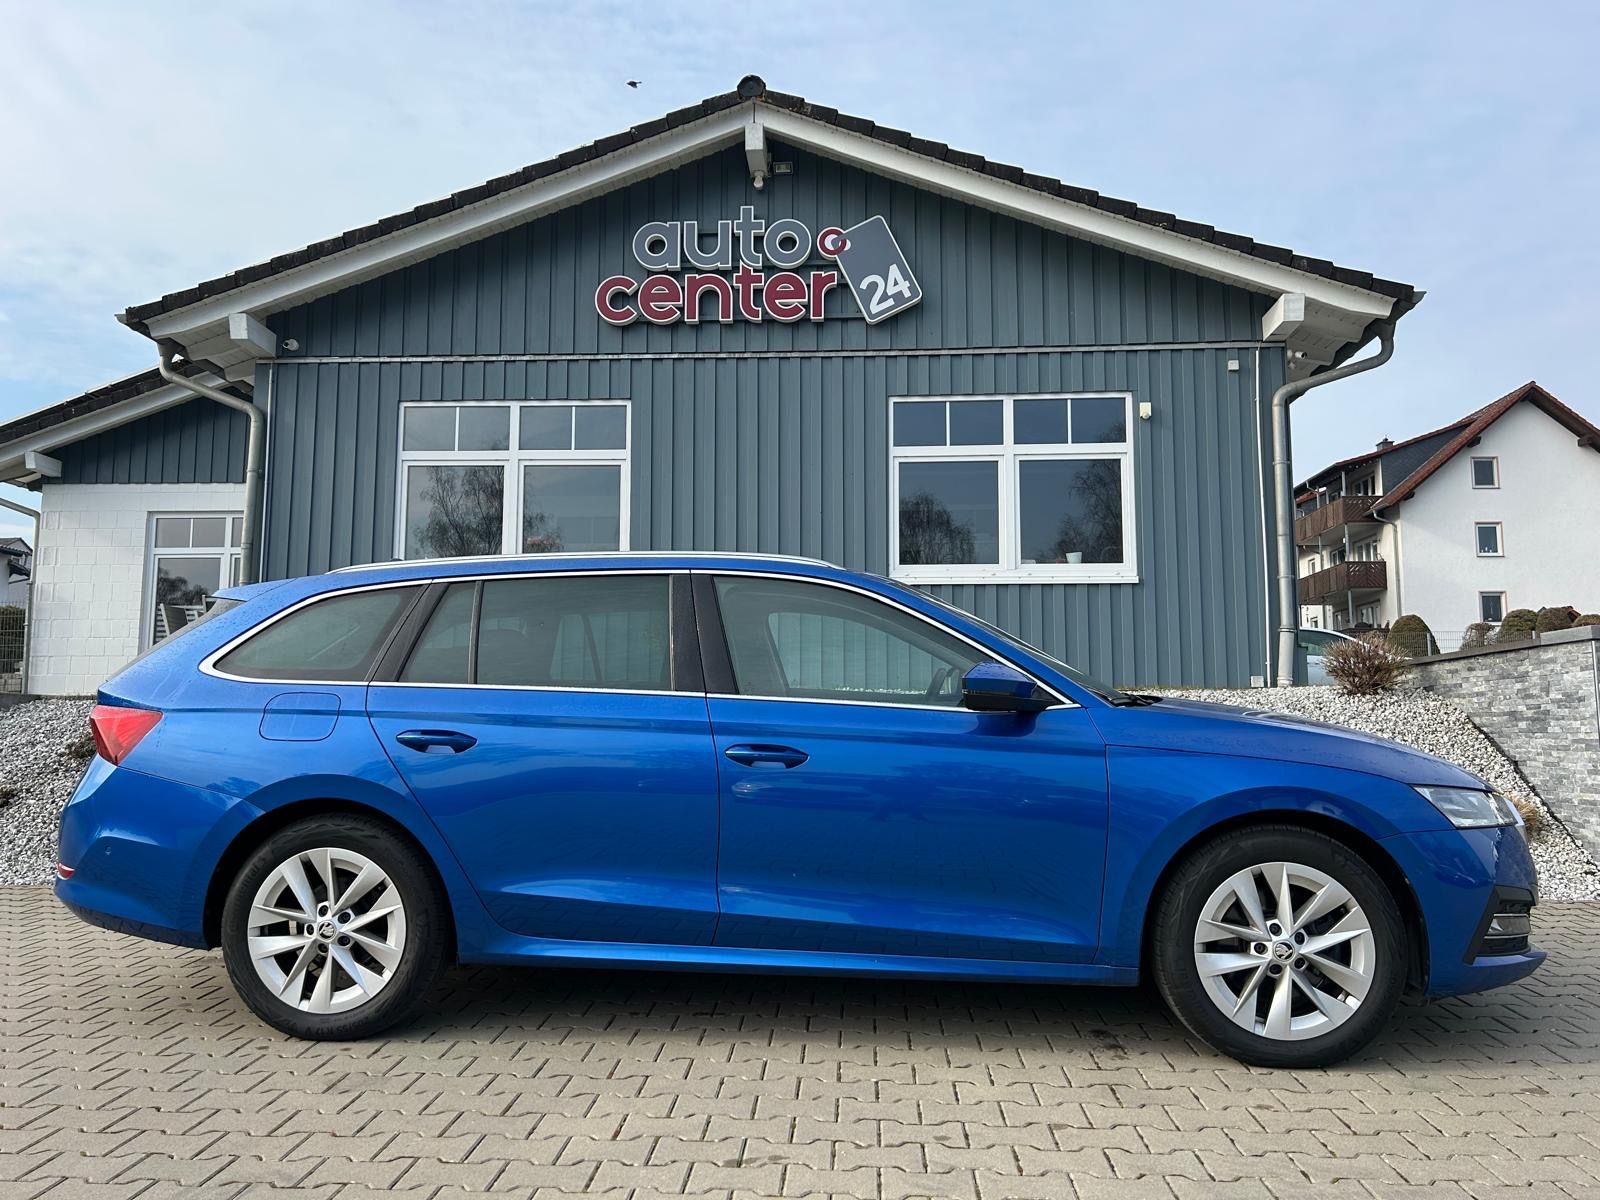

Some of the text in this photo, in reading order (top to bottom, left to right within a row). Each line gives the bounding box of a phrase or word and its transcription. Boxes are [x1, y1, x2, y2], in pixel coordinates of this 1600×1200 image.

[633, 206, 811, 270] auto
[595, 260, 837, 325] center
[859, 263, 911, 315] 24
